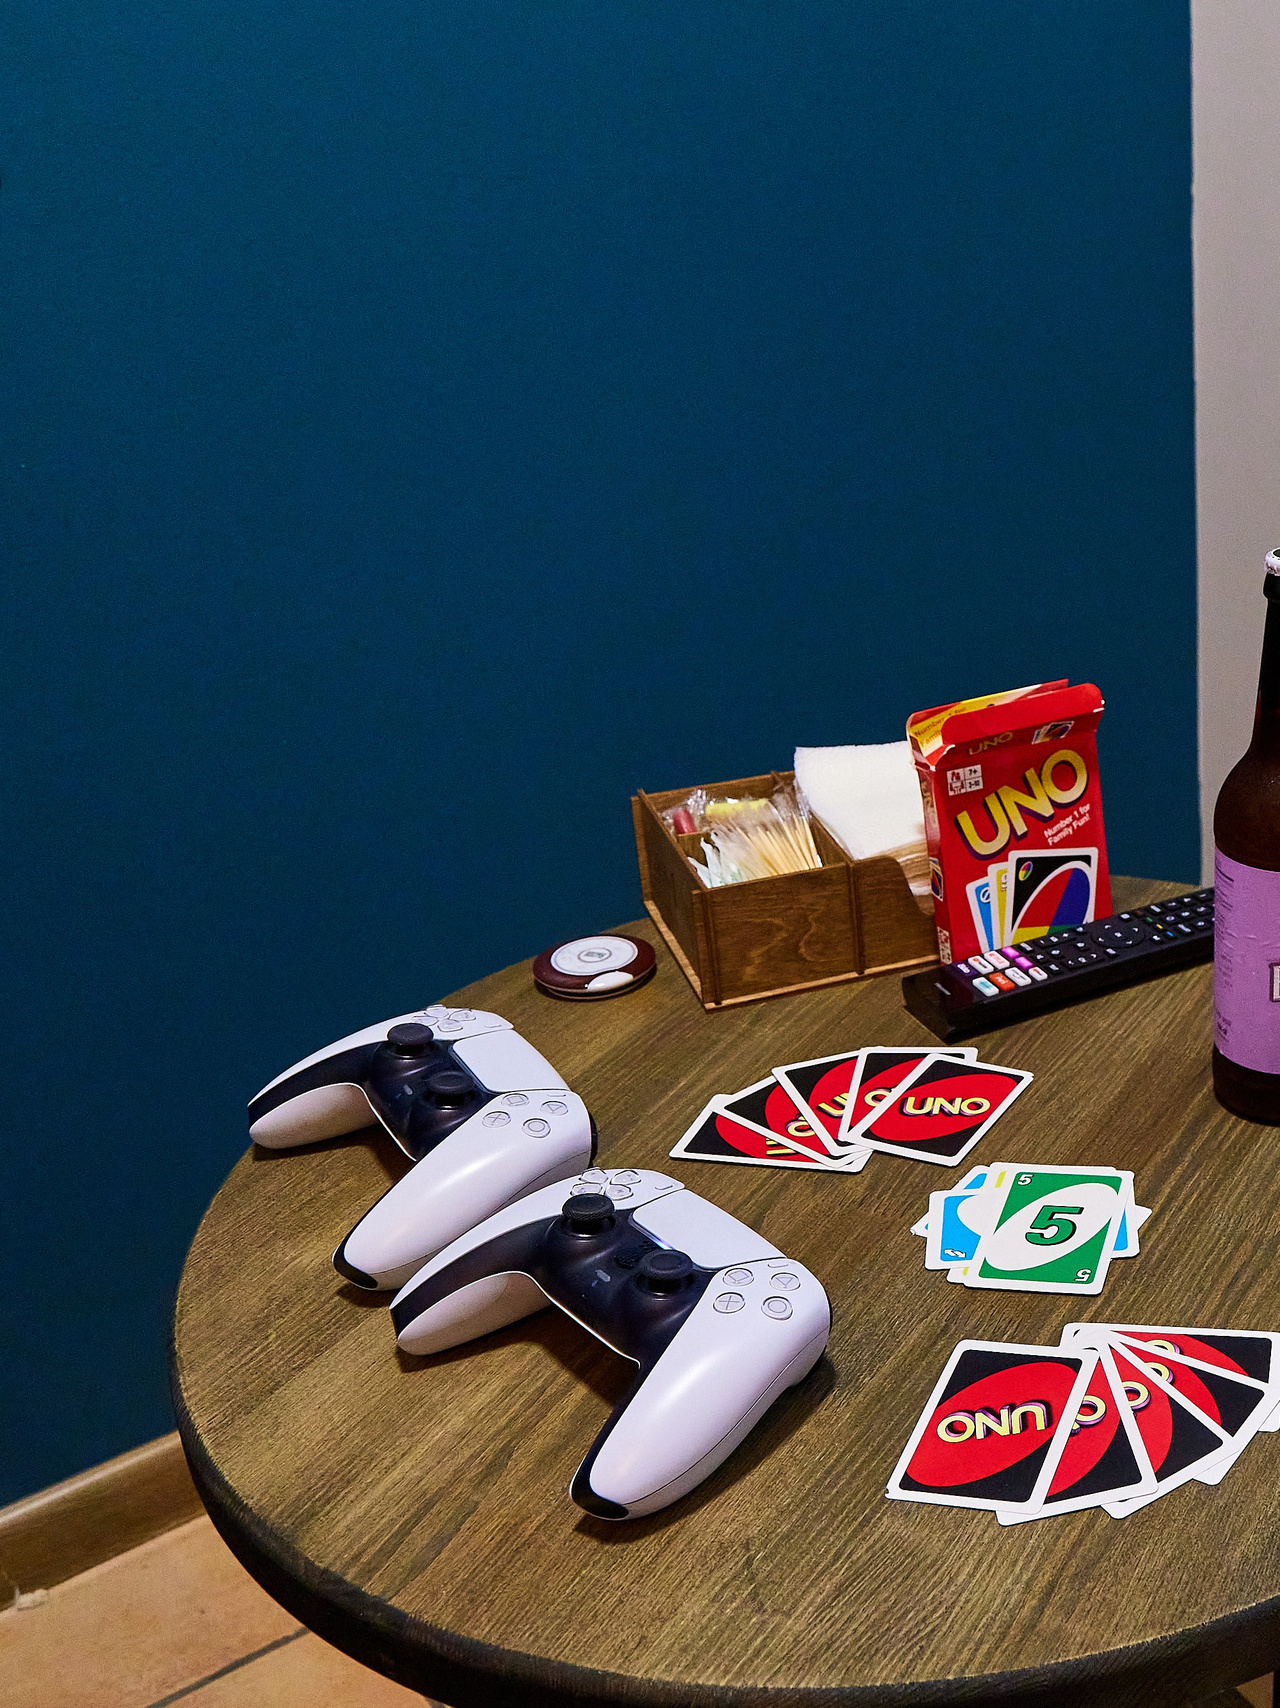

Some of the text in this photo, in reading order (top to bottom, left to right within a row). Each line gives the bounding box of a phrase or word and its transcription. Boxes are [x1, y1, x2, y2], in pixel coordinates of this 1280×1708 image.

[968, 731, 1014, 756] UNO
[954, 749, 1088, 860] UNO
[1043, 803, 1090, 838] Number 1 for
[1047, 813, 1090, 846] Family Fun!
[902, 1096, 991, 1116] UNO
[1017, 1174, 1034, 1186] 5
[1024, 1204, 1084, 1246] 5
[1074, 1269, 1092, 1282] 5
[937, 1402, 1051, 1443] UNO
